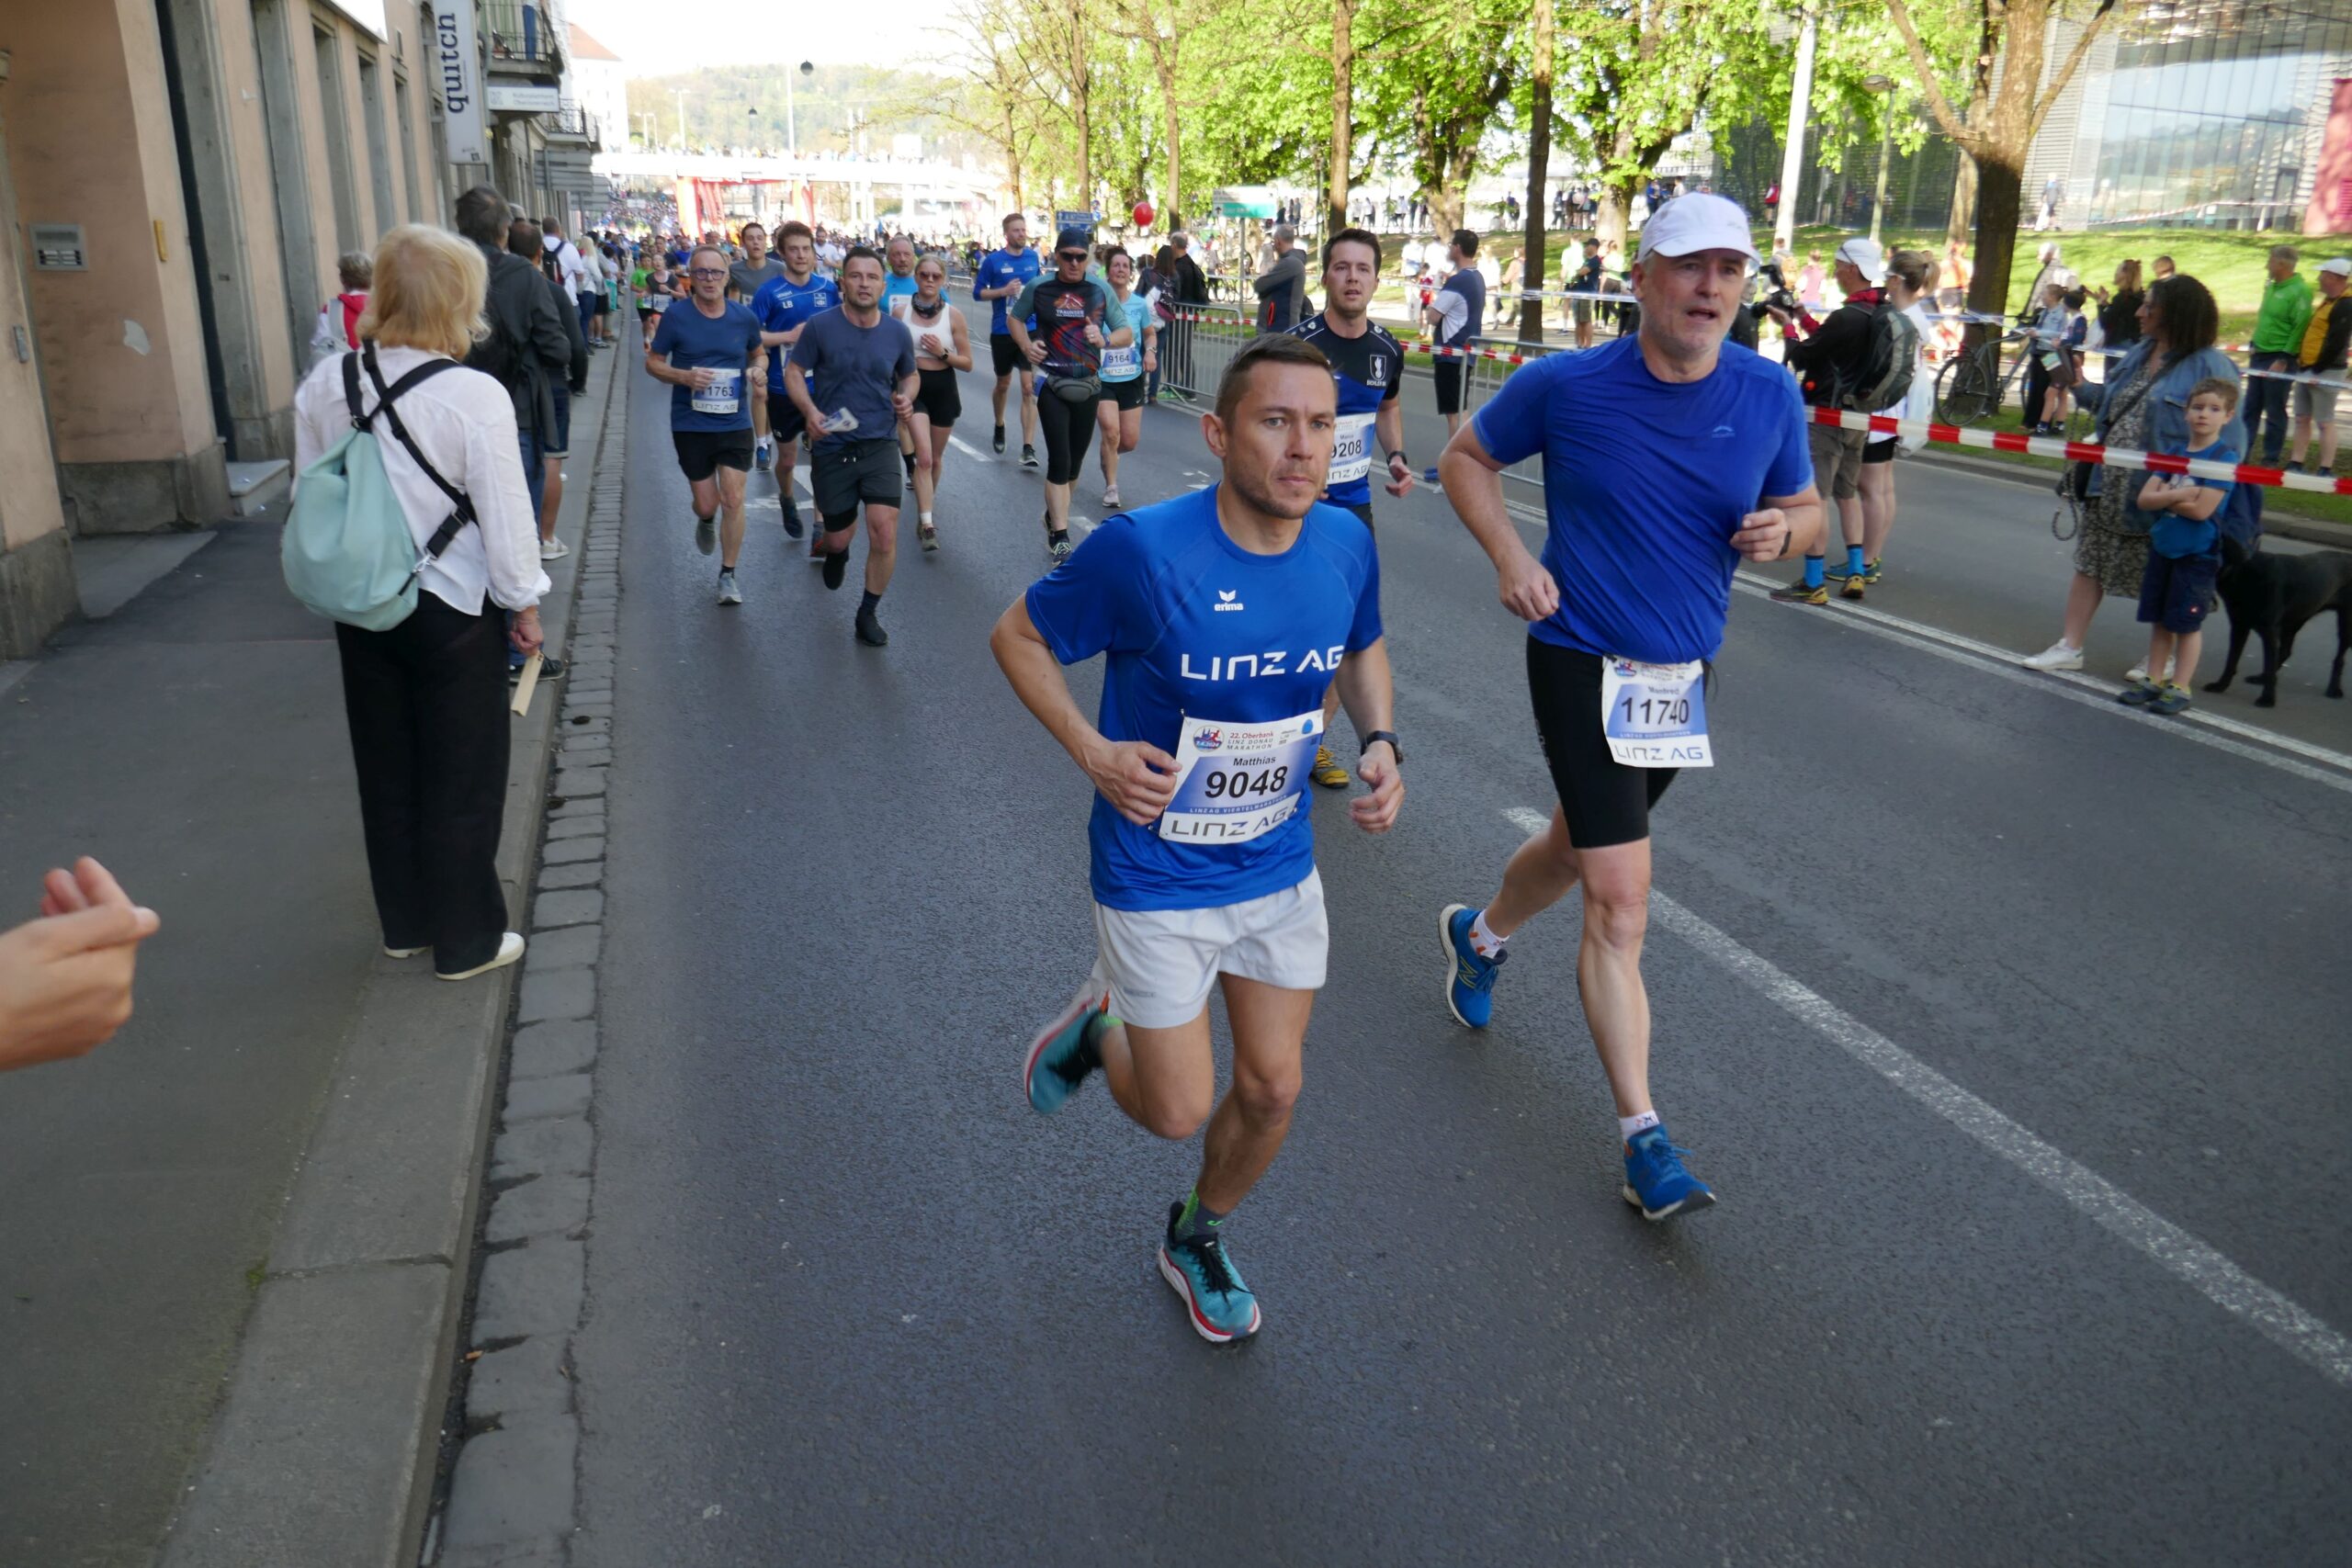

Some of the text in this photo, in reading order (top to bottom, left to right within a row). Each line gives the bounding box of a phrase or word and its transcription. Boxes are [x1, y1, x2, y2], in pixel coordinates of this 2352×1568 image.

[437, 13, 469, 114] quitch
[783, 300, 794, 309] LB
[1108, 354, 1130, 364] 9164
[701, 386, 735, 397] 1763
[1214, 602, 1244, 612] erima
[1181, 645, 1344, 682] LINZ AG
[1621, 697, 1690, 726] 11740
[1241, 730, 1274, 739] Oberbank
[1614, 744, 1704, 761] LINZ AG
[1233, 755, 1276, 766] Matthias
[1204, 765, 1289, 799] 9048
[1170, 806, 1289, 837] LINZ AG
